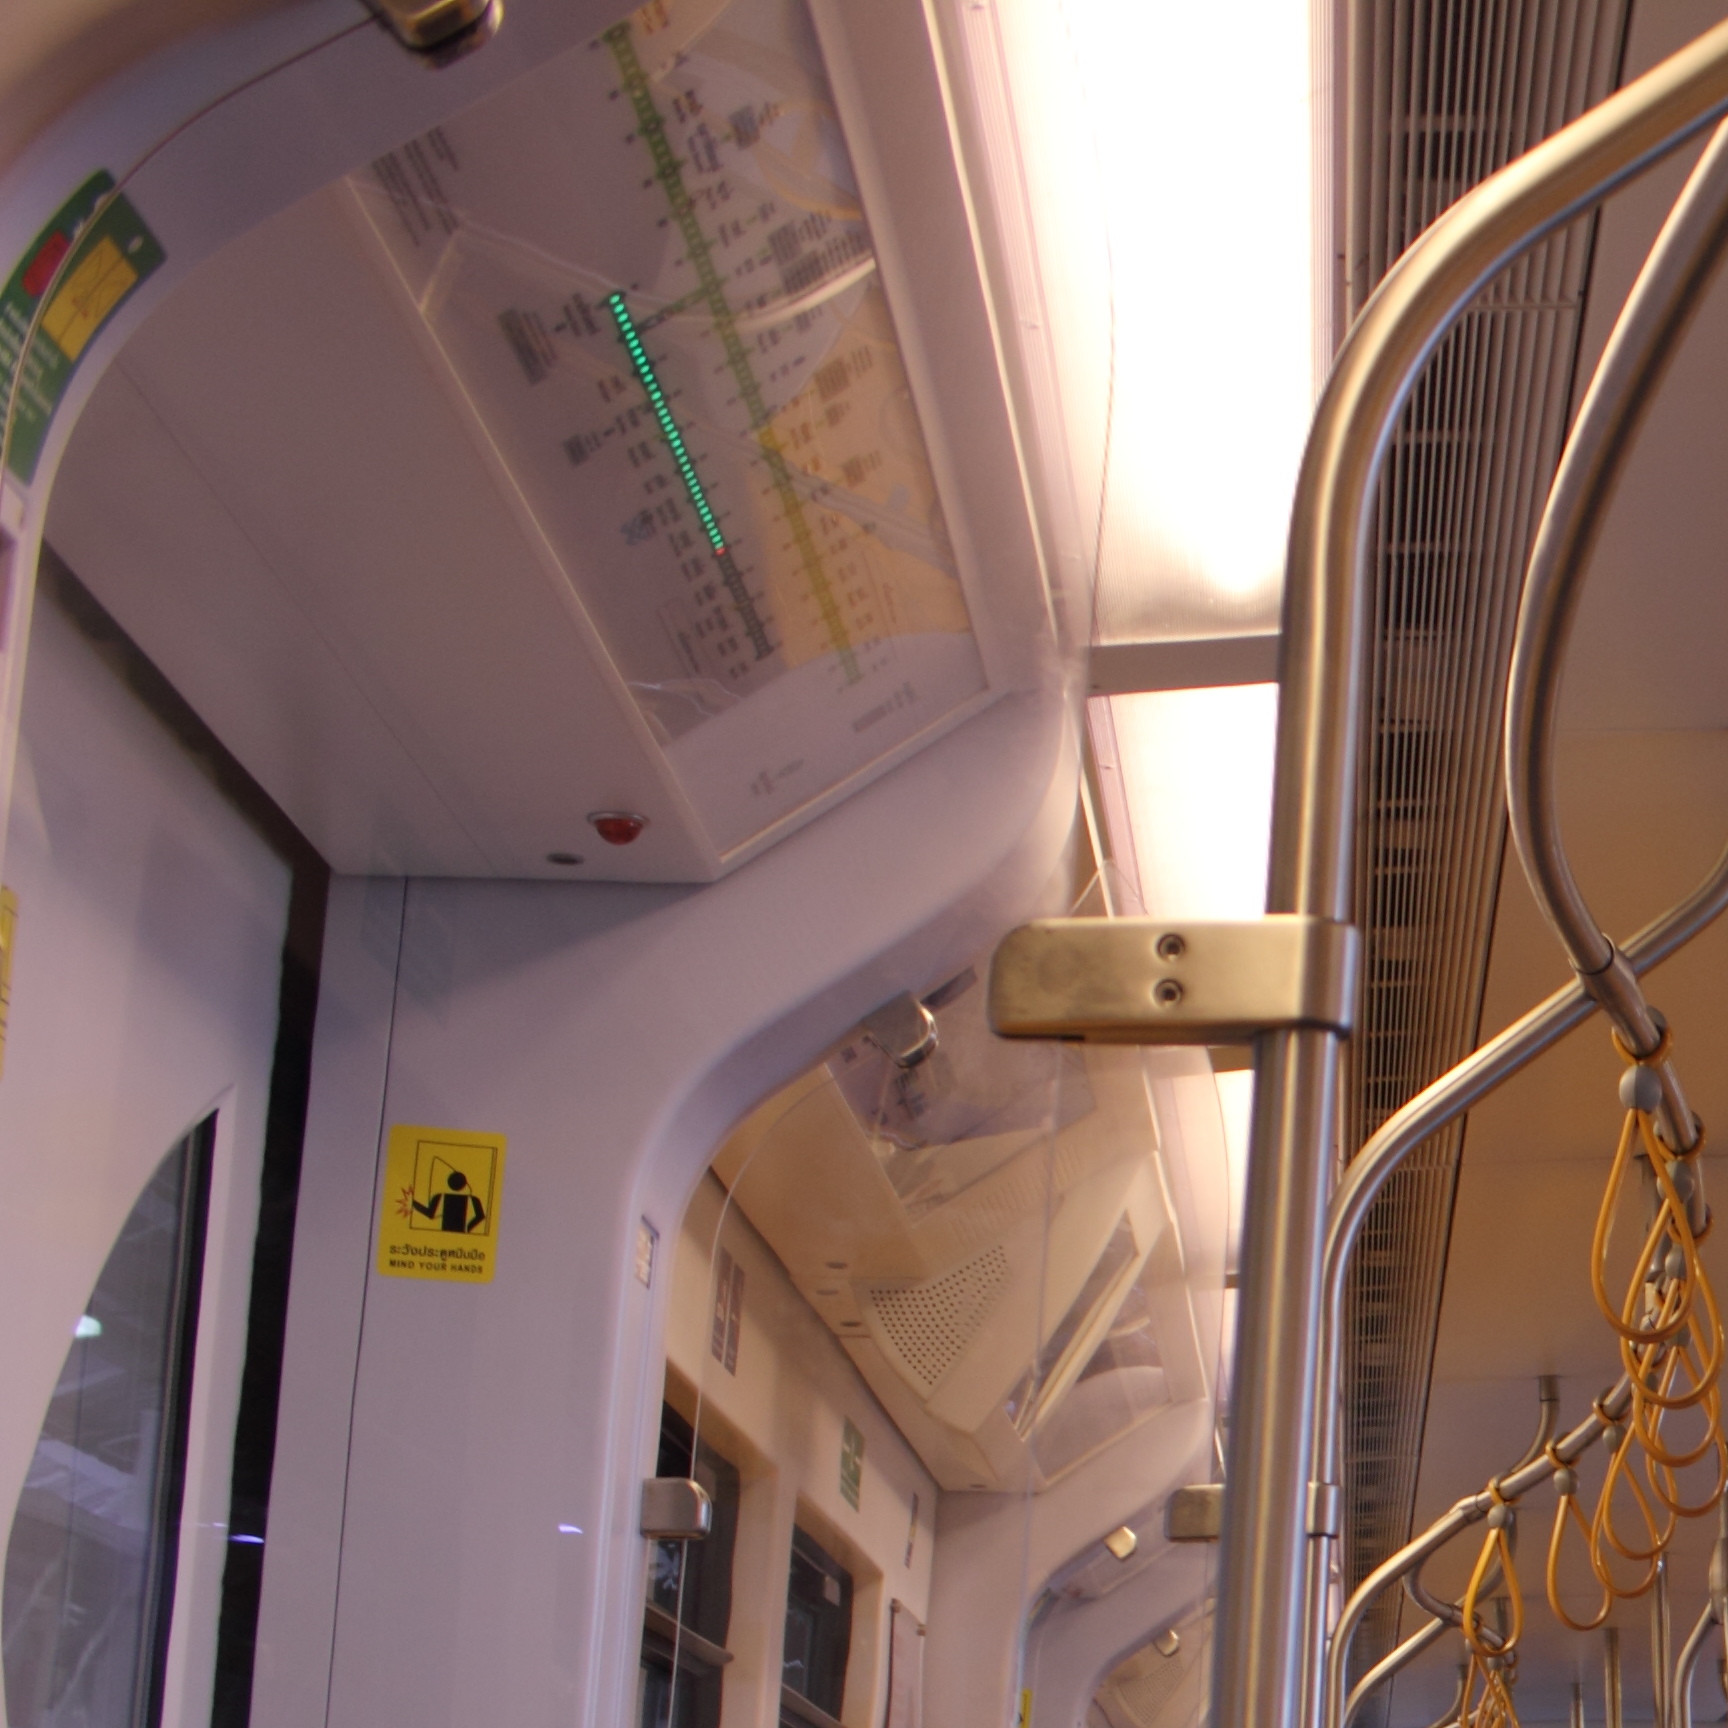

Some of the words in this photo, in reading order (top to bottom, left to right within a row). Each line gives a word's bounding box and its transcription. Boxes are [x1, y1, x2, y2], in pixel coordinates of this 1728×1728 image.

[389, 1259, 415, 1270] MIND
[419, 1261, 447, 1272] YOUR
[450, 1263, 483, 1275] HANDS
